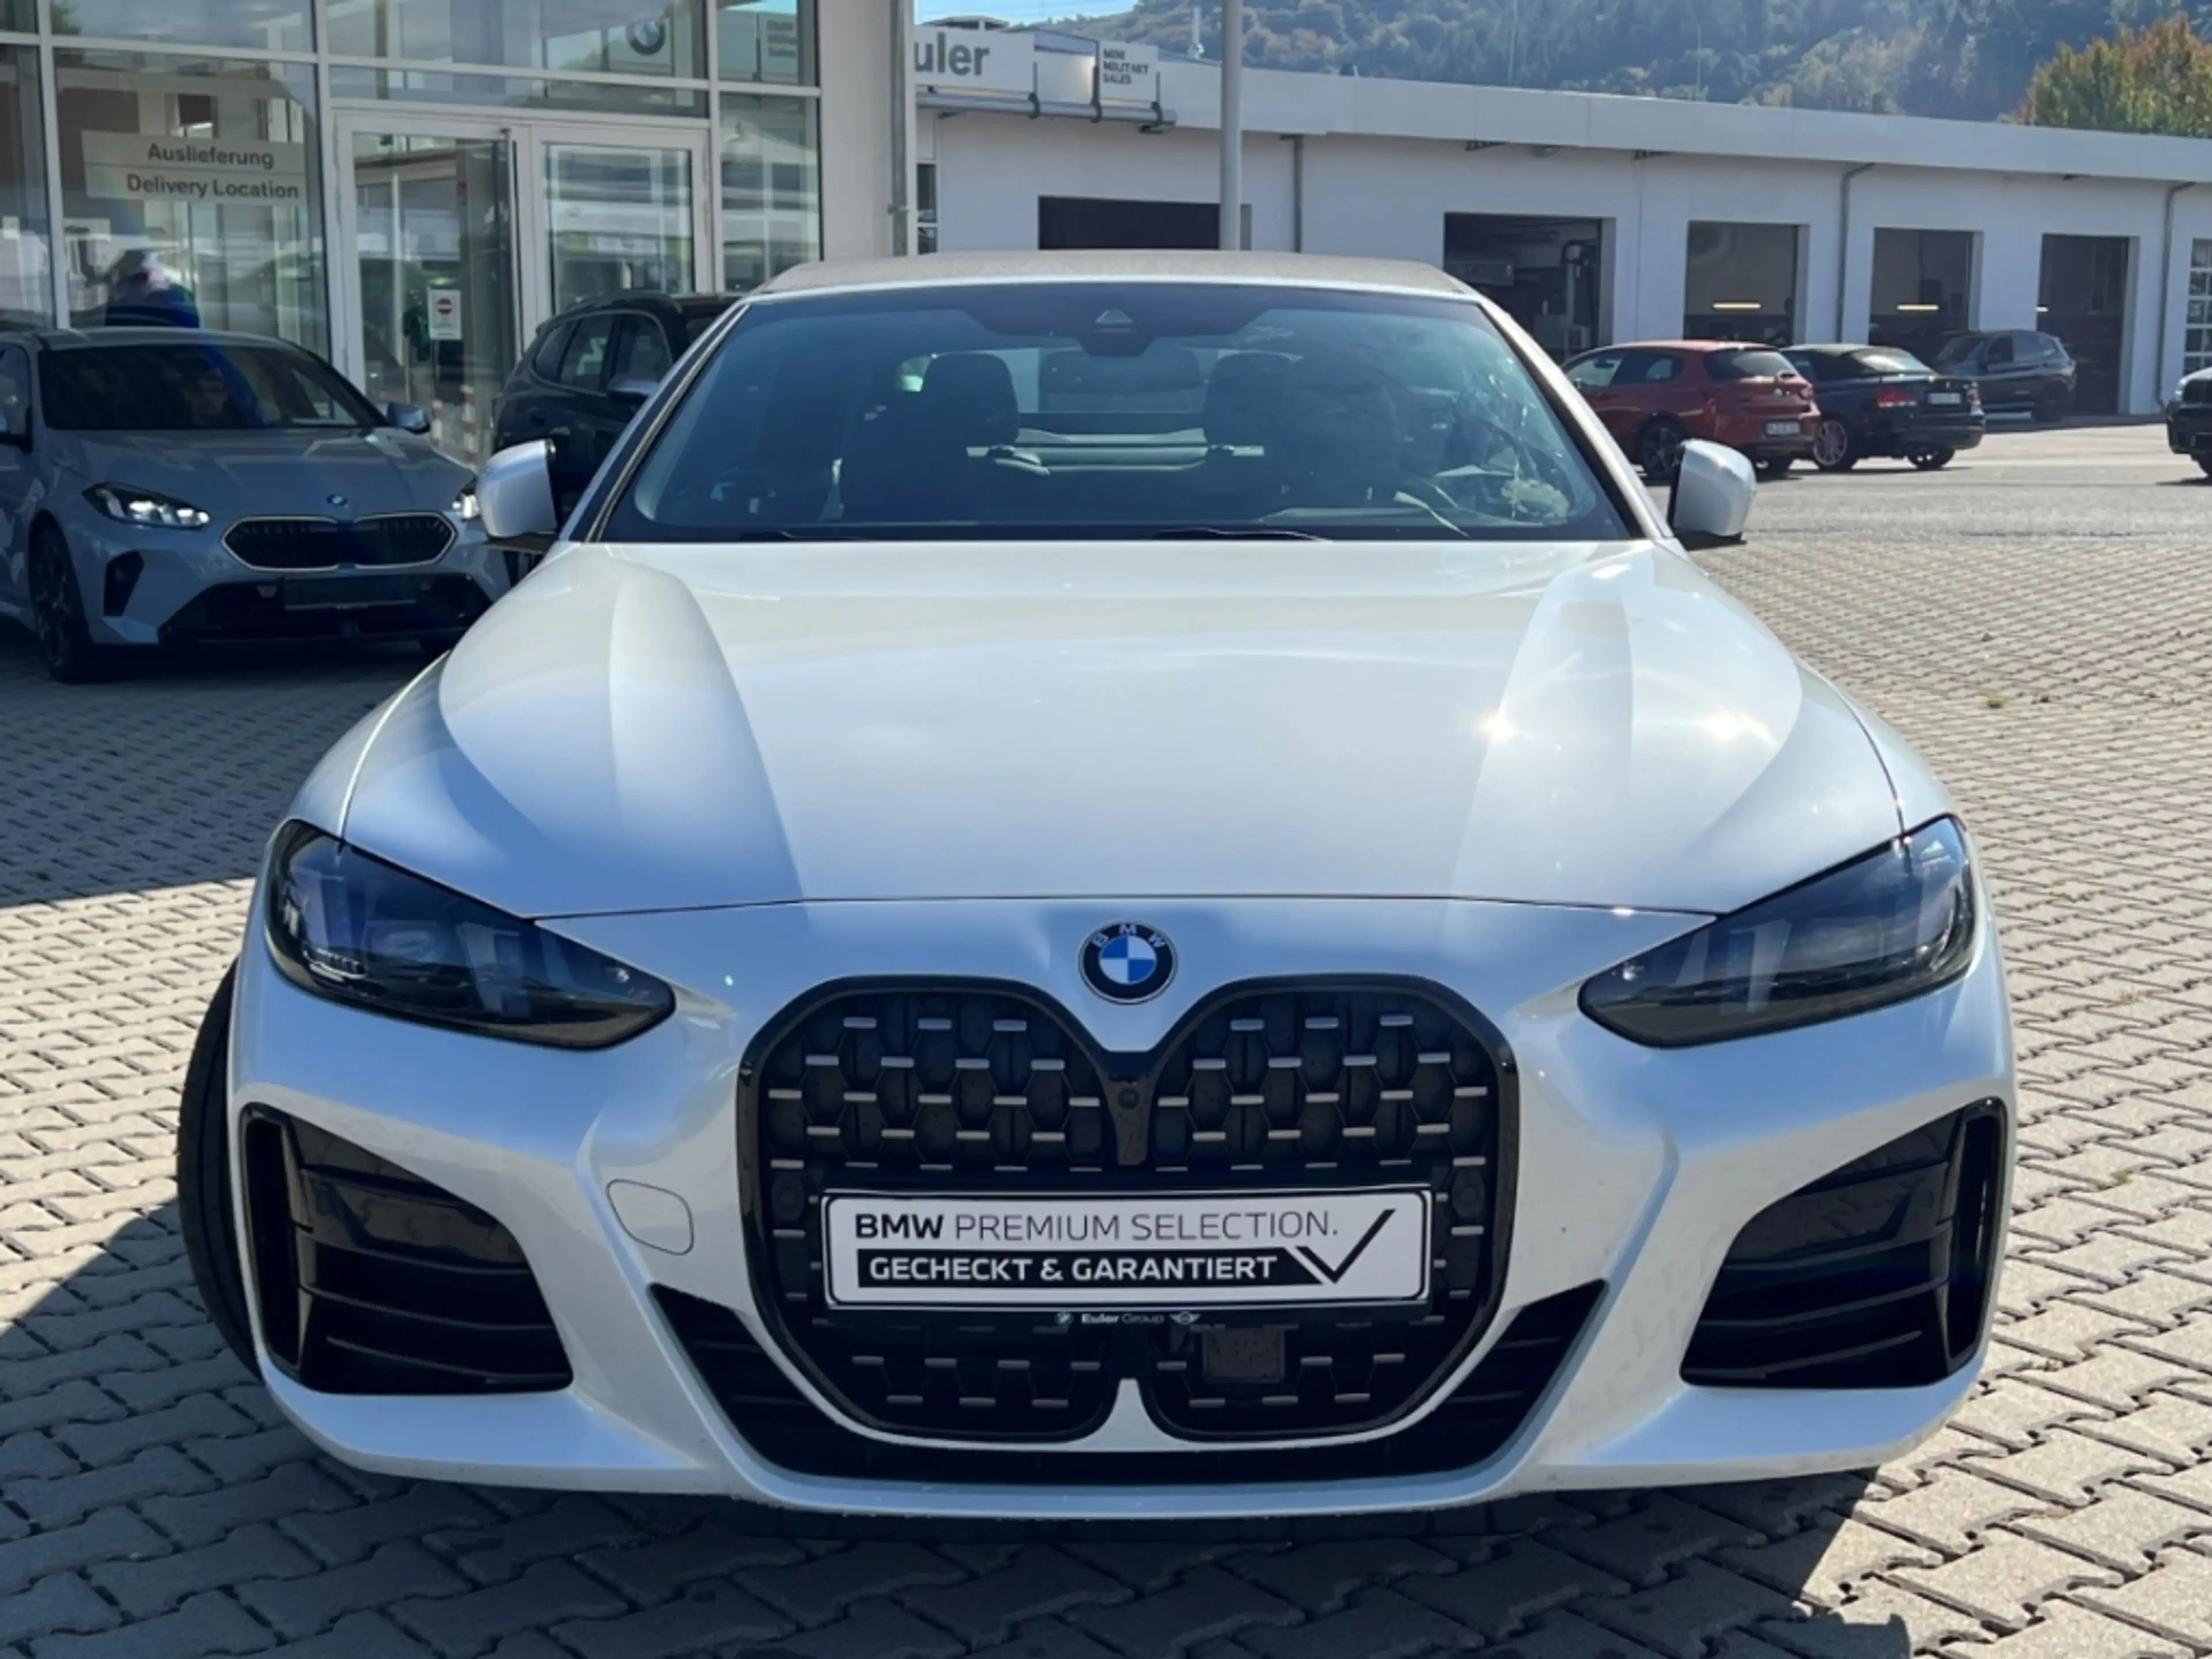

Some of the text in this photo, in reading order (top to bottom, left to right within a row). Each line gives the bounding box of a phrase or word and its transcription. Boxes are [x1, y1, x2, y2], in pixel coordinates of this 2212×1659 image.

[1104, 60, 1149, 74] MILITARY
[1103, 75, 1132, 85] SALES
[148, 143, 274, 169] Auslieferung
[127, 173, 299, 199] Delivery Location
[1090, 923, 1165, 948] BMW
[855, 1210, 1338, 1241] BMW PREMIUM SELECTION.
[869, 1255, 1278, 1281] GECHECKT & GARANTIERT
[1081, 1313, 1165, 1325] Euler Group
